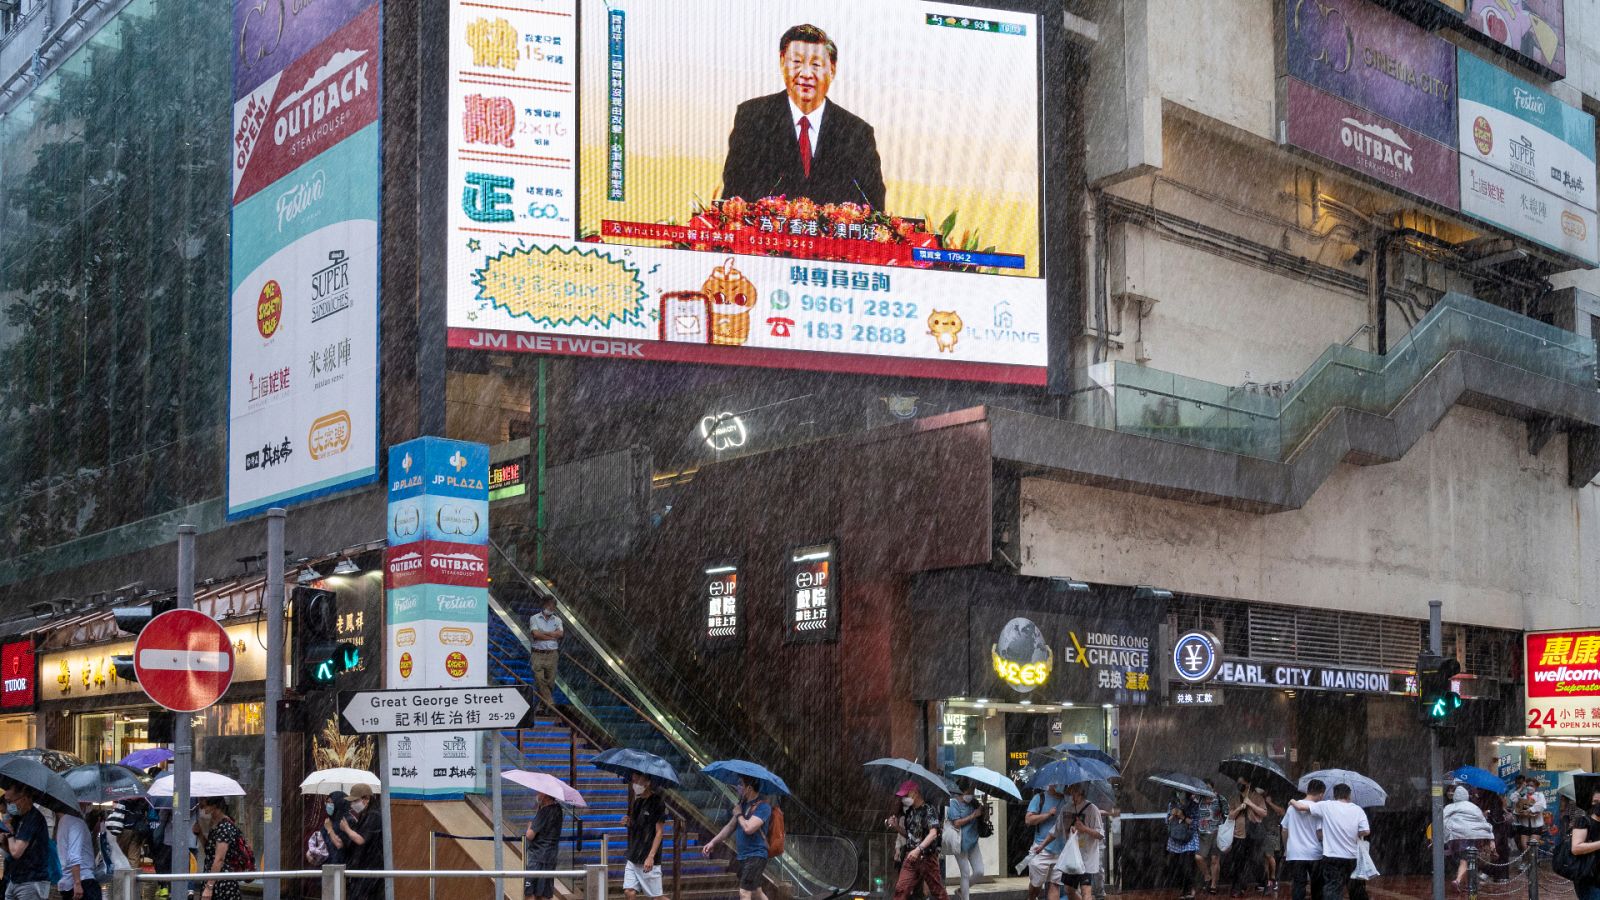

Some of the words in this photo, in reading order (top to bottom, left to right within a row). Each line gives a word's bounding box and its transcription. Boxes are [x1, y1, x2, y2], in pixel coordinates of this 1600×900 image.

[1363, 48, 1418, 89] CINEMA
[1420, 72, 1448, 100] CITY
[274, 61, 369, 146] OUTBACK
[235, 94, 258, 147] NOW
[237, 96, 269, 170] OPEN!
[291, 114, 346, 156] STEAKHOUSE
[1341, 127, 1413, 175] OUTBACK
[1509, 141, 1536, 167] SUPER
[1356, 157, 1402, 179] STEAKHOUSE
[312, 263, 349, 301] SUPER
[790, 265, 891, 292] 與專員查詢
[311, 292, 350, 321] SANDWICHES
[801, 294, 854, 314] 9661
[864, 299, 918, 320] 2832
[469, 332, 508, 348] JM
[516, 334, 644, 357] NETWORK
[803, 321, 843, 341] 183
[852, 325, 907, 345] 2888
[308, 337, 352, 378] 米線陣
[248, 366, 290, 403] 上海姥姥
[392, 481, 400, 492] JP
[399, 475, 423, 490] PLAZA
[432, 475, 445, 485] JP
[447, 476, 484, 490] PLAZA
[391, 558, 423, 572] OUTBACK
[430, 558, 484, 572] OUTBACK
[723, 581, 736, 596] JP
[813, 571, 826, 586] JP
[336, 611, 364, 634] 老鳳祥
[1065, 632, 1149, 668] EXCHANGE
[1087, 632, 1118, 646] HONG
[1120, 634, 1149, 648] KONG
[1539, 635, 1600, 666] 惠康
[5, 678, 26, 692] TUDOR
[1275, 666, 1312, 686] CITY
[1321, 671, 1389, 691] MANSION
[371, 696, 408, 708] Great
[412, 694, 459, 708] George
[464, 693, 504, 705] Street
[361, 717, 380, 726] 1-19
[395, 710, 481, 728] 記利佐治街
[488, 712, 516, 721] 25-29
[1527, 708, 1557, 729] 24
[443, 741, 467, 751] SUPER
